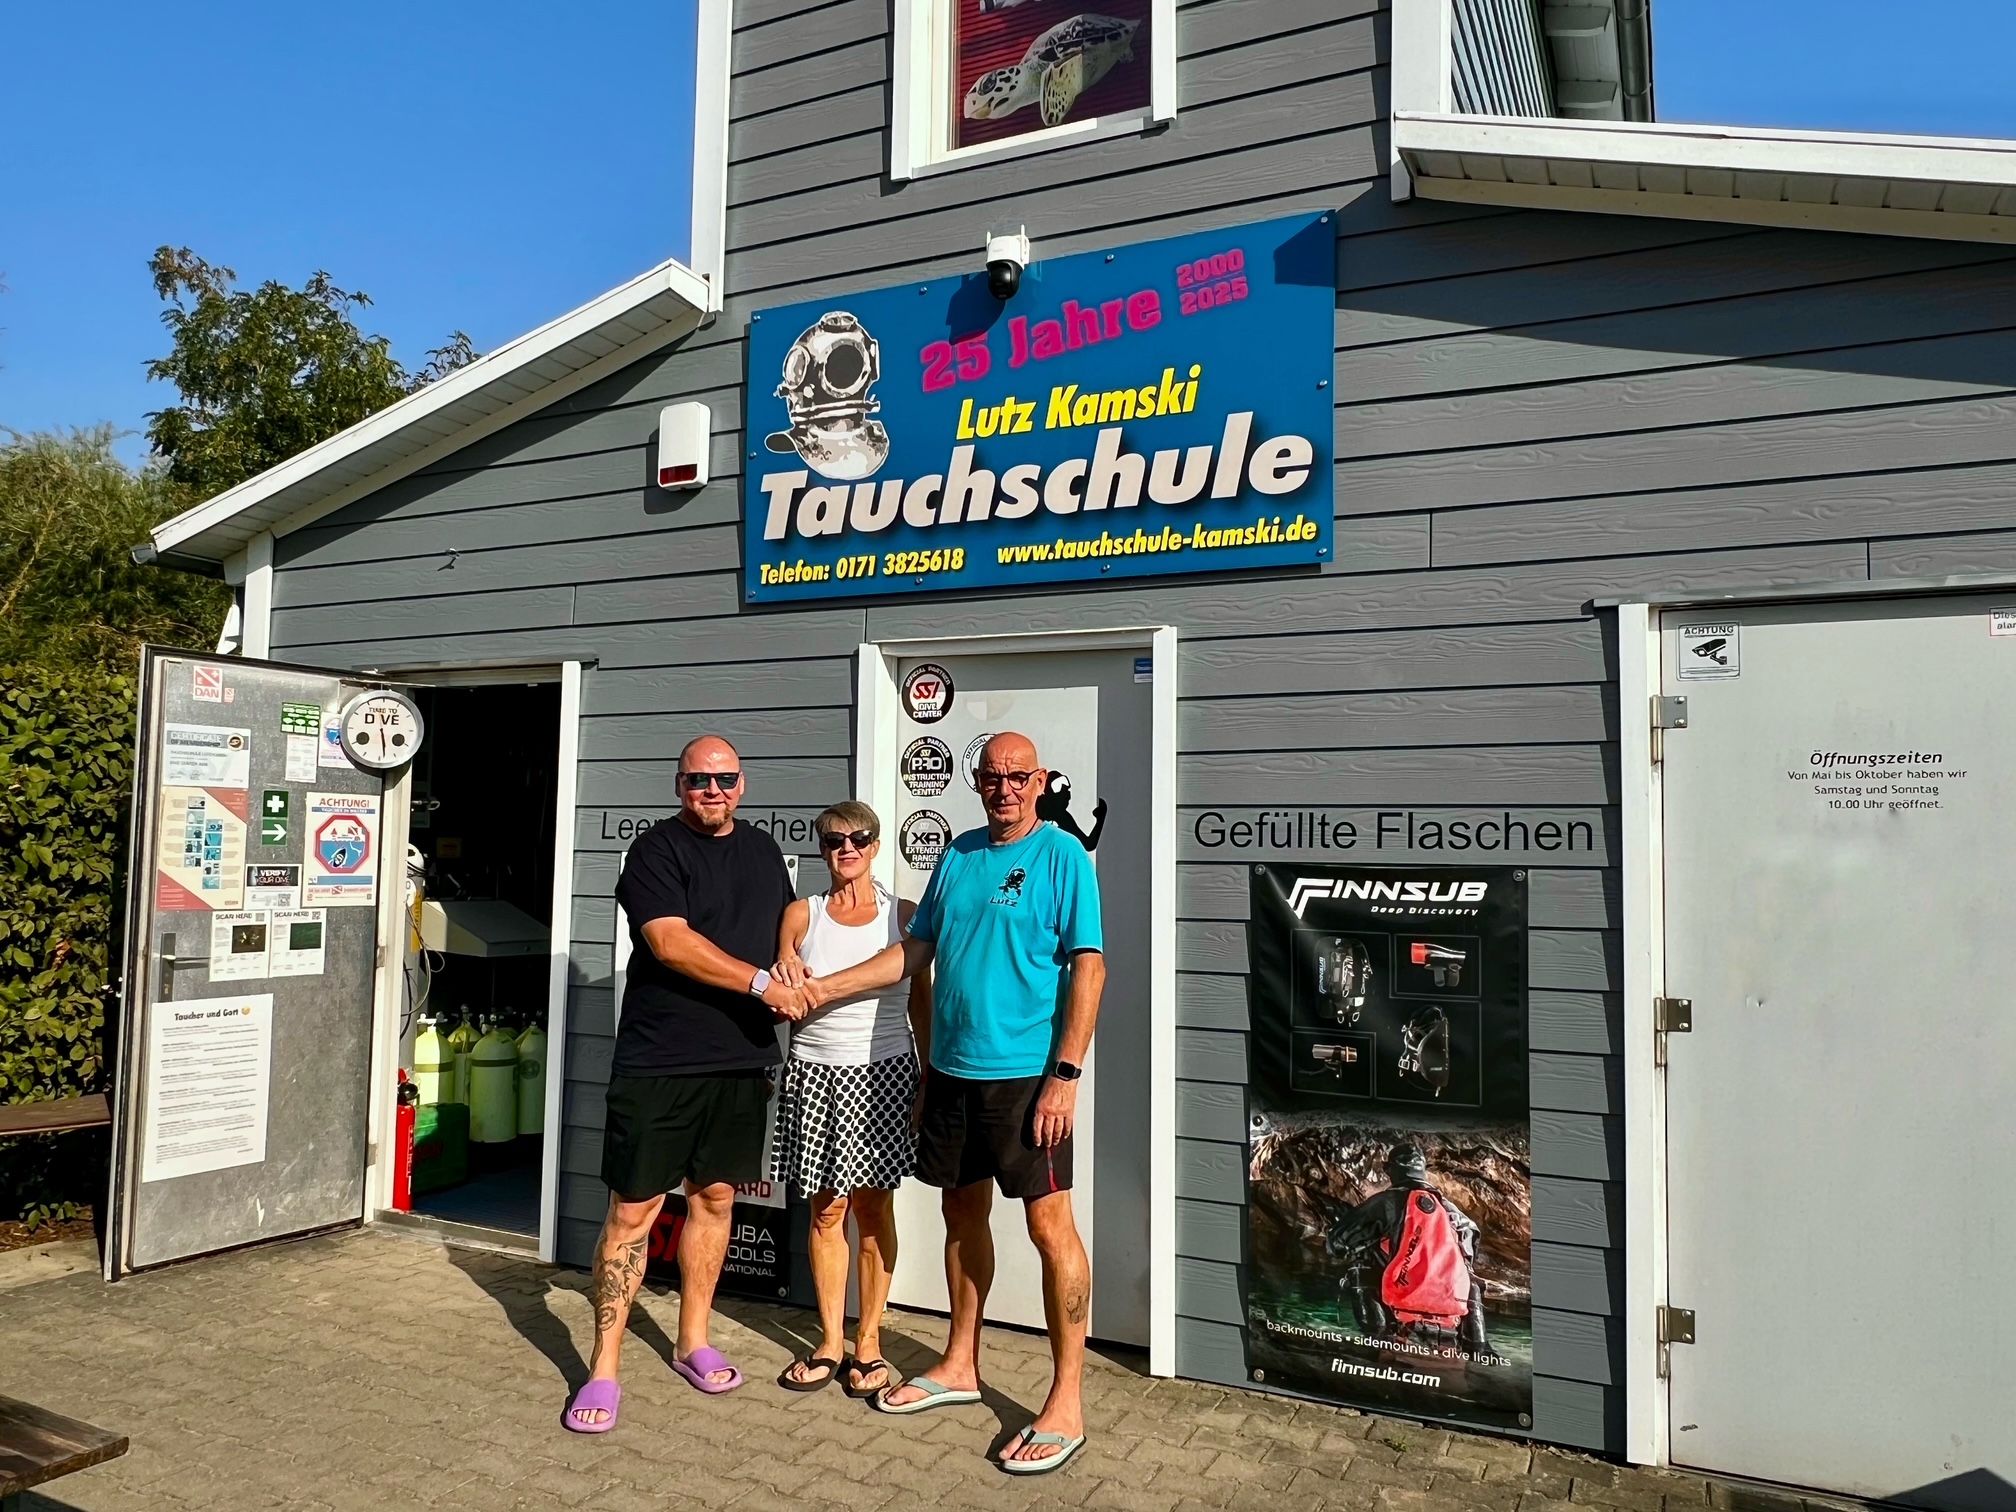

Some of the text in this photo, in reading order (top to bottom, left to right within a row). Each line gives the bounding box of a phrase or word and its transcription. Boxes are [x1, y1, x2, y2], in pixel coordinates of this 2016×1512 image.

[1176, 248, 1246, 288] 2000
[1180, 276, 1249, 316] 2025
[920, 290, 1162, 392] 25 Jahre
[956, 365, 1202, 440] Lutz Kamski
[760, 411, 1313, 541] Tauchschule
[996, 515, 1317, 564] www.tauchschule-kamski.de
[760, 548, 965, 585] Telefon: 0171 3825618
[1684, 626, 1734, 635] ACHTUNG
[195, 687, 219, 699] DAN
[913, 681, 941, 700] SSI
[364, 713, 400, 726] DVE
[913, 710, 942, 718] CENTER
[911, 757, 942, 770] PRO
[1810, 750, 1942, 767] Öffnungszeiten
[903, 773, 951, 781] INSTRUCTOR
[1788, 769, 1968, 780] Von Mai bis Oktober haben wir
[909, 780, 945, 788] TRAINING
[1814, 784, 1939, 796] Samstag und Sonntag
[912, 788, 942, 796] CENTER
[319, 797, 370, 808] ACHTUNG!
[1828, 799, 1944, 810] 10.00 Uhr geöffnet.
[1194, 811, 1594, 851] Gefüllte Flaschen
[911, 832, 941, 845] XR
[912, 854, 939, 862] RANGE
[1286, 878, 1488, 919] FINNSUB
[1371, 905, 1479, 917] Deep Discovery
[174, 1011, 204, 1021] Taucher
[206, 1009, 221, 1018] und
[1266, 1318, 1512, 1367] backmounts sidemounts dive lights
[1331, 1358, 1441, 1388] finnsub.com
